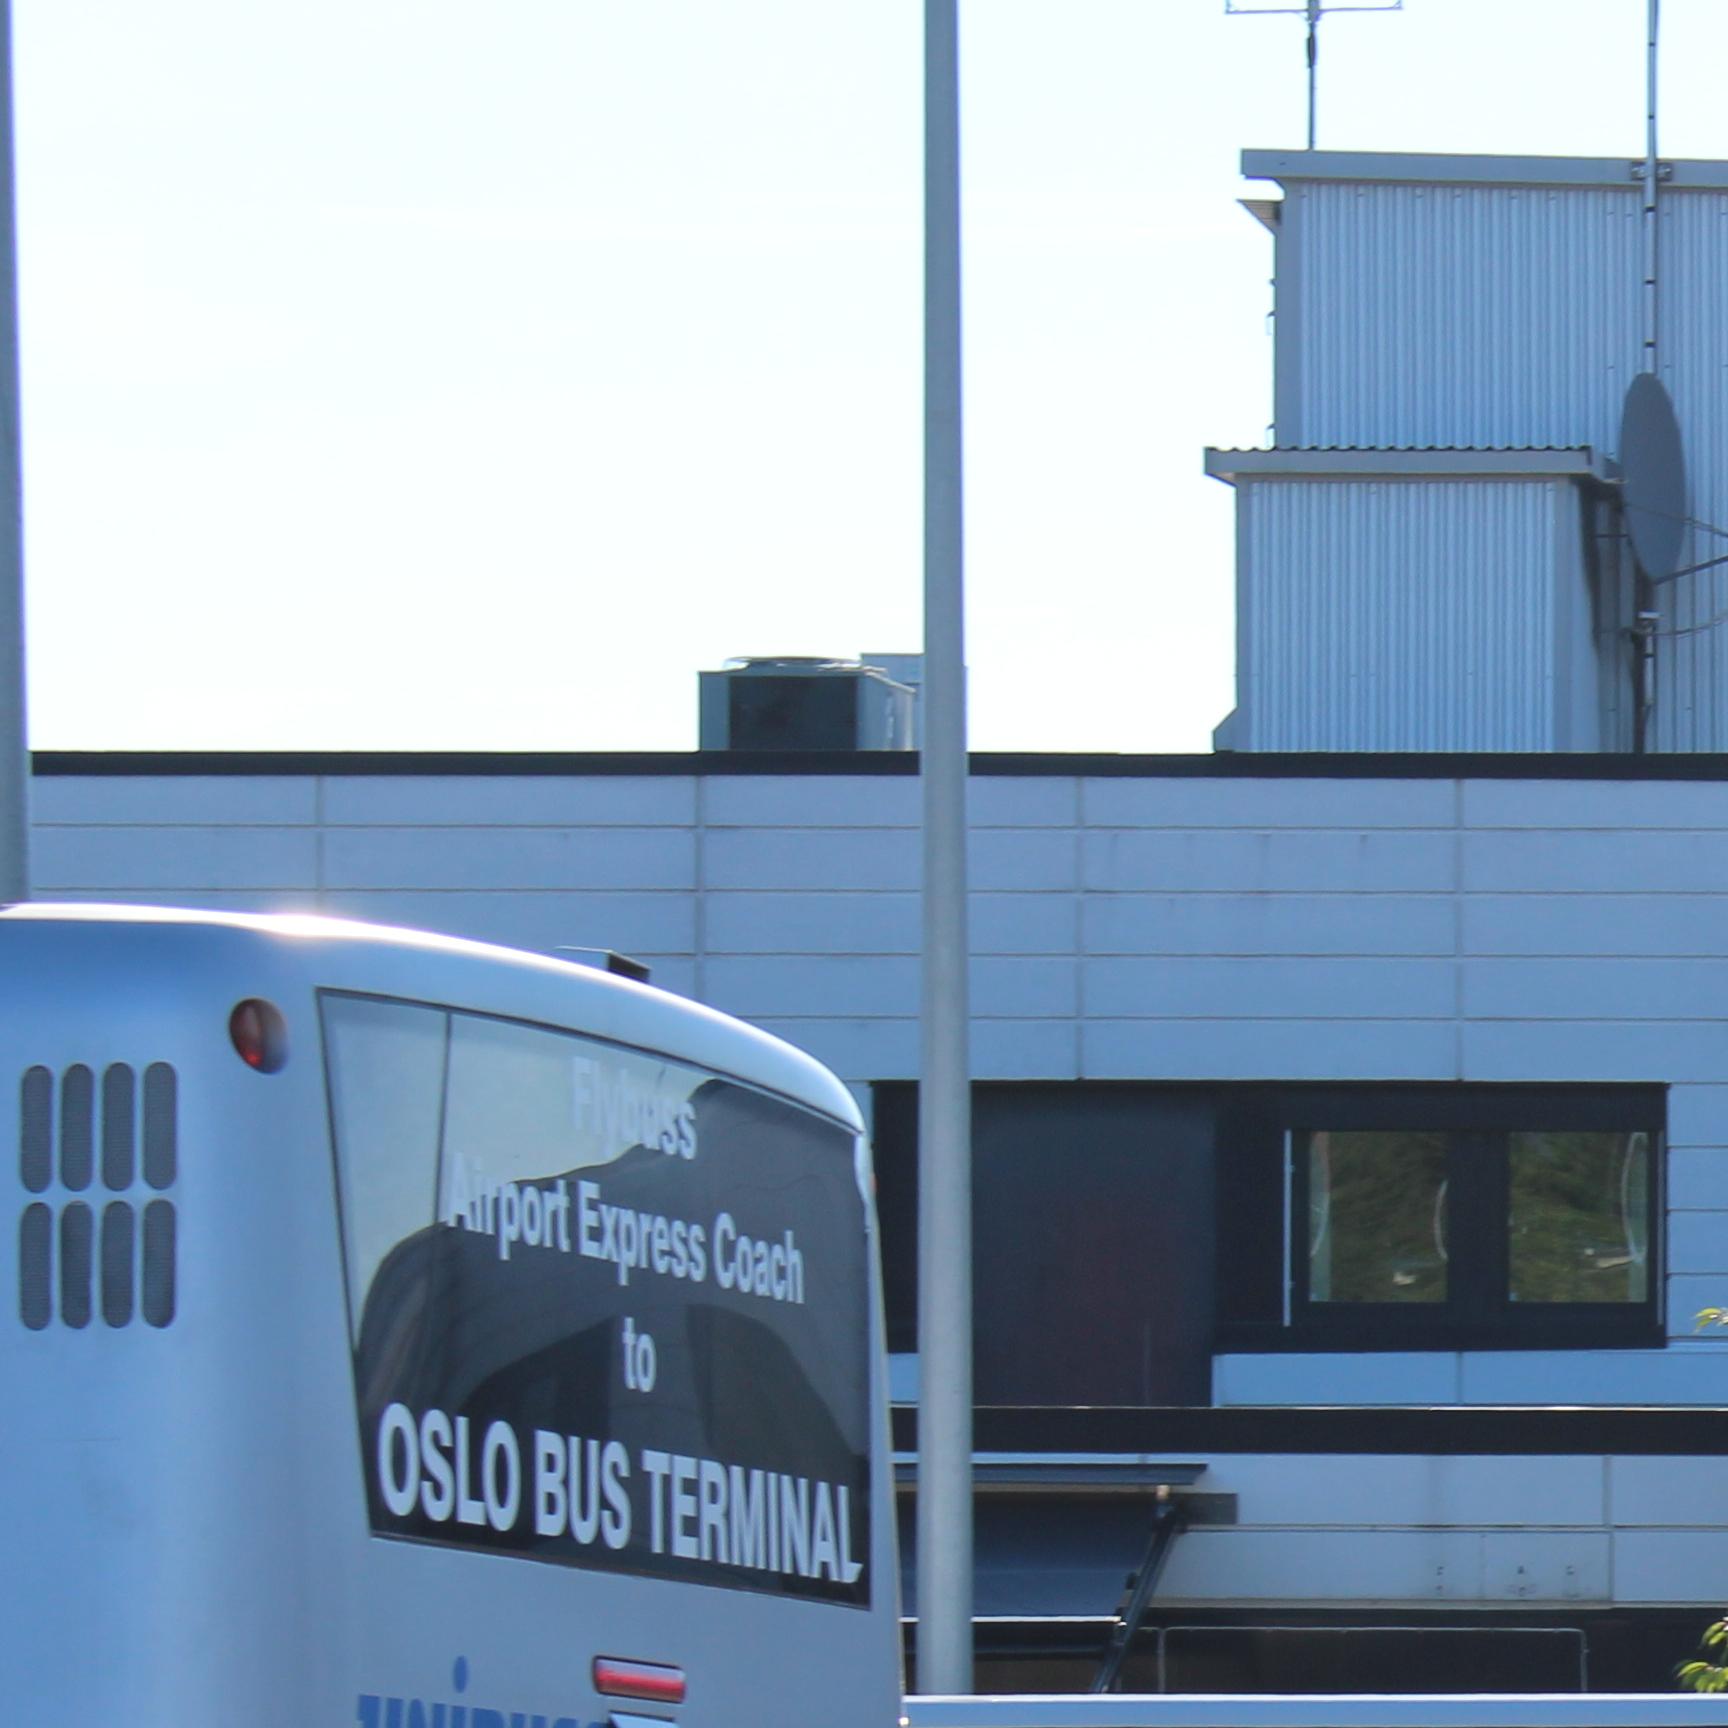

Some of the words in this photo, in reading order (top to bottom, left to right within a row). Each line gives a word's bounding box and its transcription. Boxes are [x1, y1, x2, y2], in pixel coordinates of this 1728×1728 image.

[572, 1055, 697, 1161] Flybuss
[437, 1152, 571, 1261] Airport
[578, 1180, 707, 1286] Express
[714, 1212, 805, 1304] Coach
[622, 1316, 656, 1392] to
[378, 1402, 521, 1532] OSLO
[534, 1429, 632, 1550] BUS
[642, 1449, 864, 1584] TERMINAL
